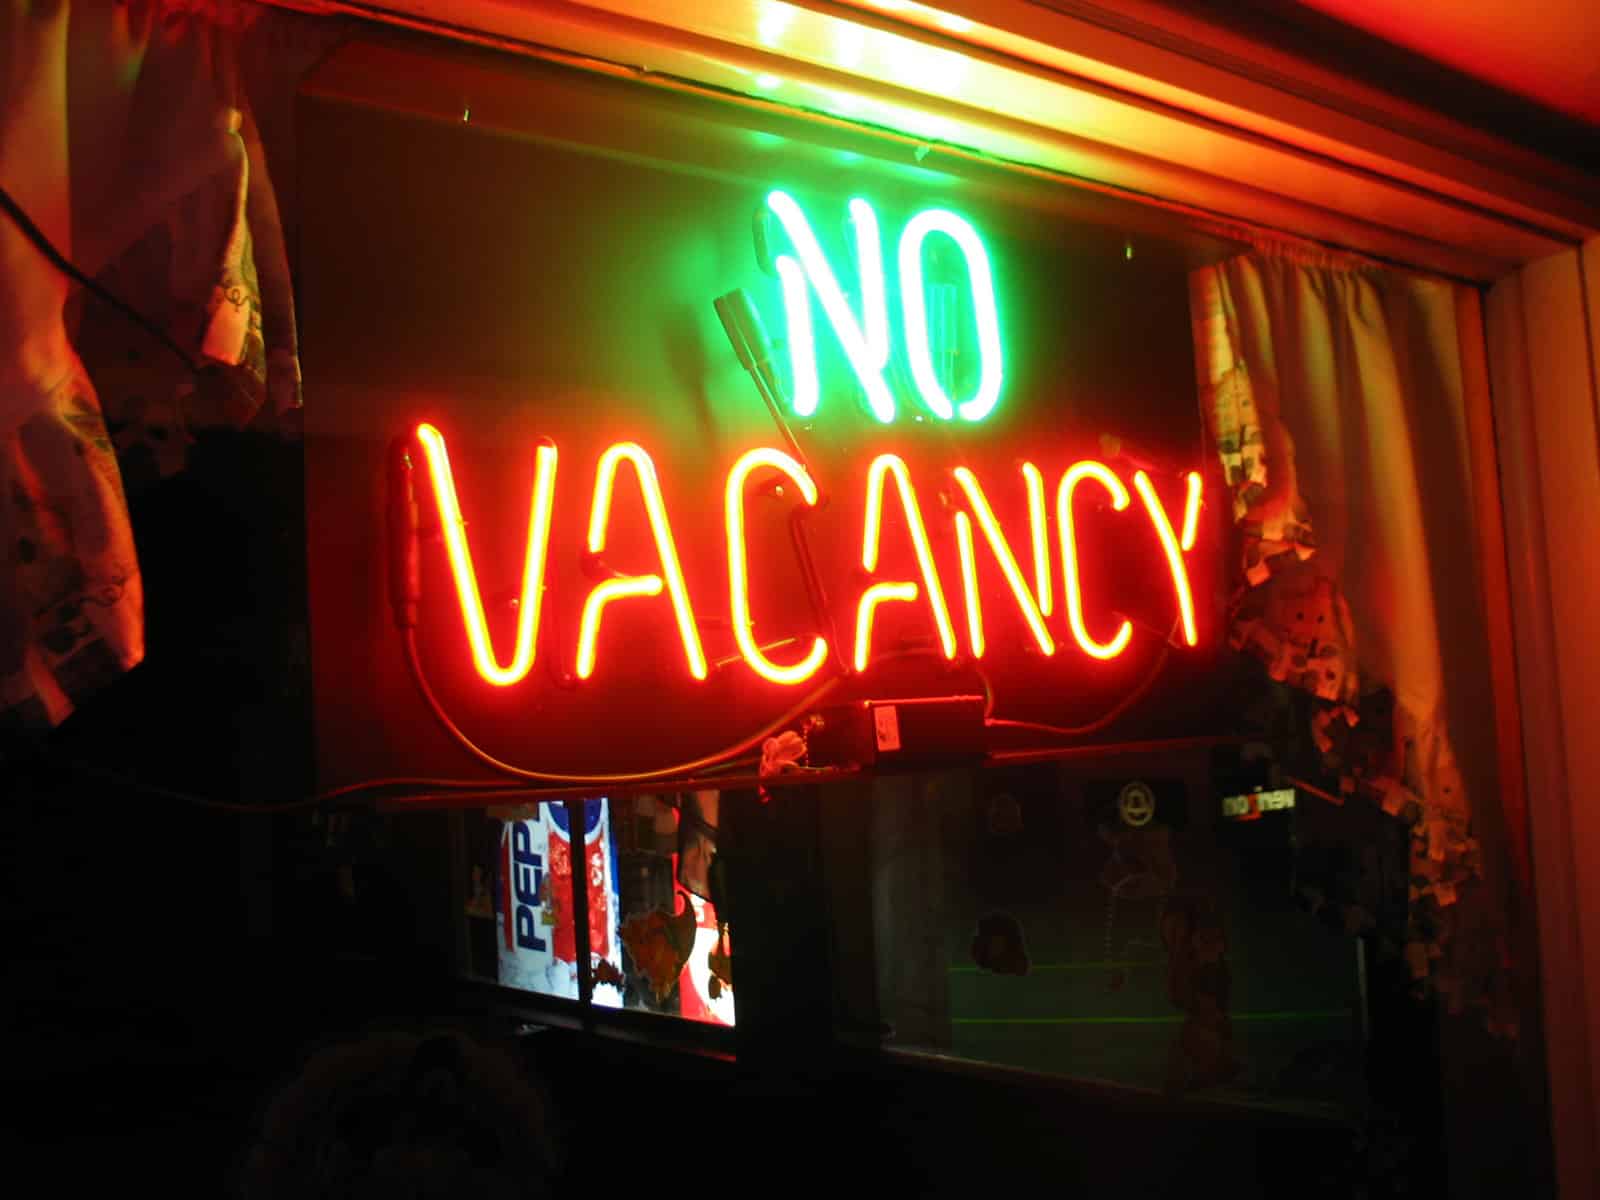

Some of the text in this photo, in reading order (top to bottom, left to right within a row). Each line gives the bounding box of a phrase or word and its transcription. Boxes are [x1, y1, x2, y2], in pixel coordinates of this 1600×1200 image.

[767, 189, 1002, 422] NO
[415, 422, 1203, 685] VACANCY
[512, 804, 547, 952] PEP
